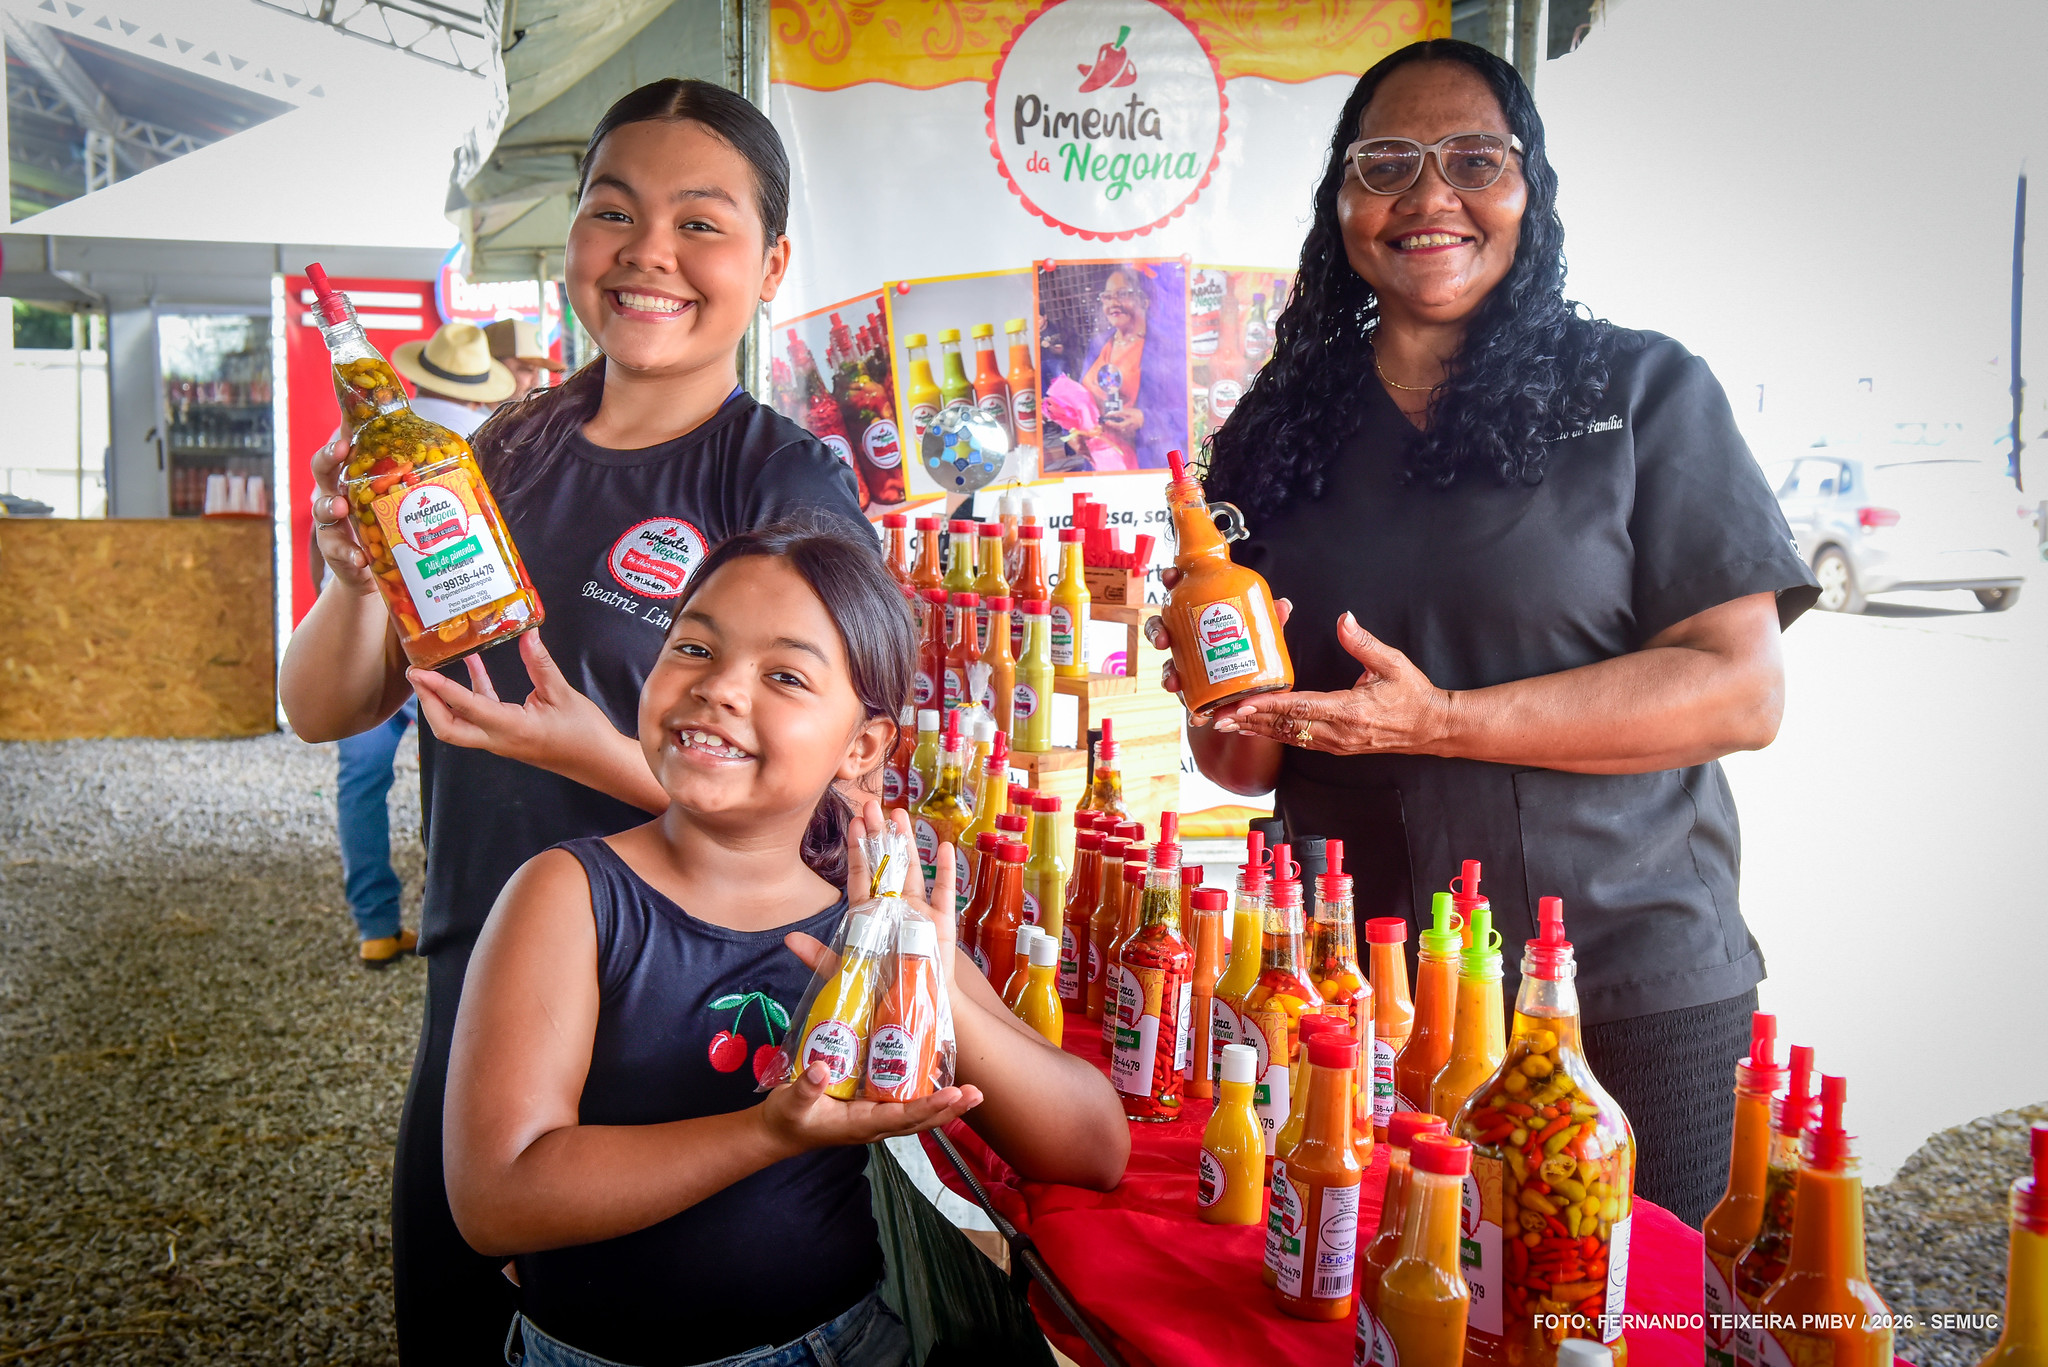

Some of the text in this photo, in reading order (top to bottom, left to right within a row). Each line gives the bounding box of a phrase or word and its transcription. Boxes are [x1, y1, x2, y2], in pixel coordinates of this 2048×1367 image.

[1015, 93, 1163, 145] Pimenta
[1026, 142, 1202, 201] da Negona
[404, 500, 451, 524] pimenta
[423, 507, 457, 527] Negona
[639, 530, 690, 554] pimenta
[652, 542, 690, 565] Negona
[425, 543, 476, 574] Mix de pimenta
[440, 576, 493, 601] @pimentadanegona
[443, 563, 495, 591] 99136-4479
[582, 581, 640, 614] Beatriz
[1203, 613, 1234, 626] pimenta
[1220, 659, 1256, 674] 99136-4479
[814, 1033, 849, 1048] pimenta
[874, 1038, 906, 1049] pimenta
